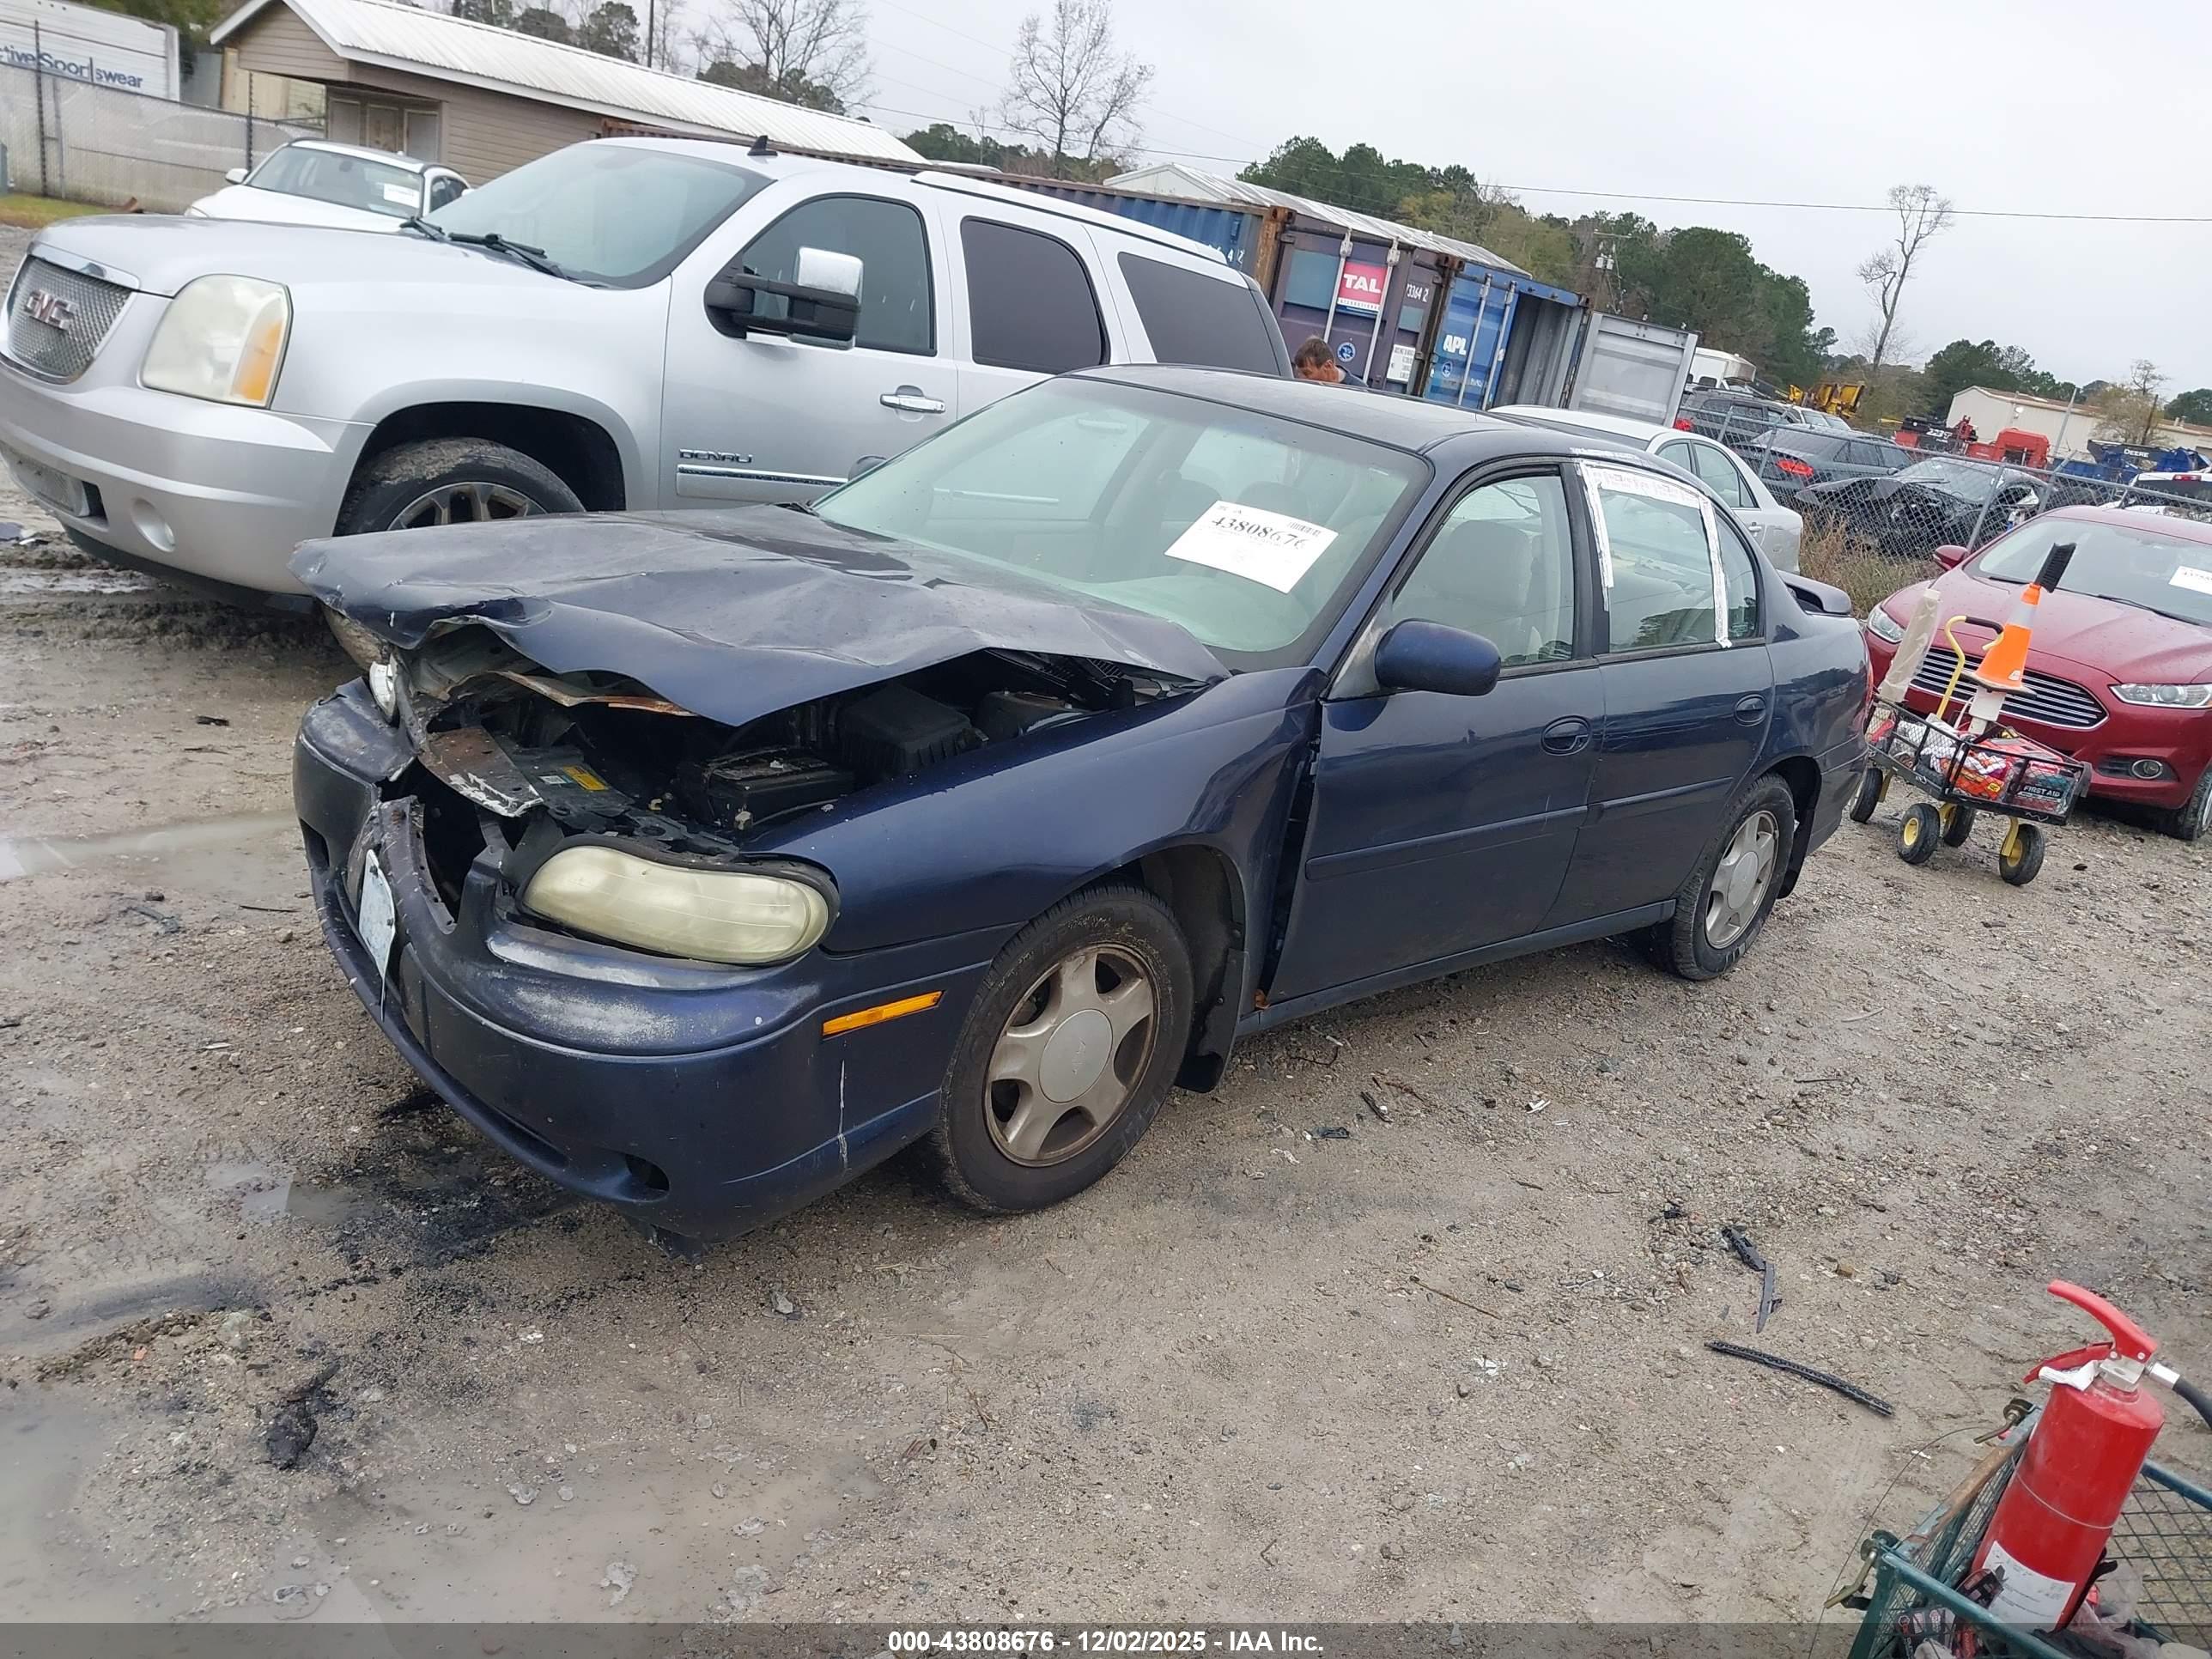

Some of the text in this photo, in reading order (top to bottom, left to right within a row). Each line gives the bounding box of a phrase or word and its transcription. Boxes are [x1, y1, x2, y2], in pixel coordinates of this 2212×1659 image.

[1343, 273, 1382, 294] TAL
[24, 290, 78, 331] GMC
[1443, 334, 1467, 356] APL
[679, 448, 753, 463] DENALI
[1211, 516, 1309, 550] 43808676
[2023, 785, 2046, 796] FIRST
[2045, 787, 2061, 798] AID
